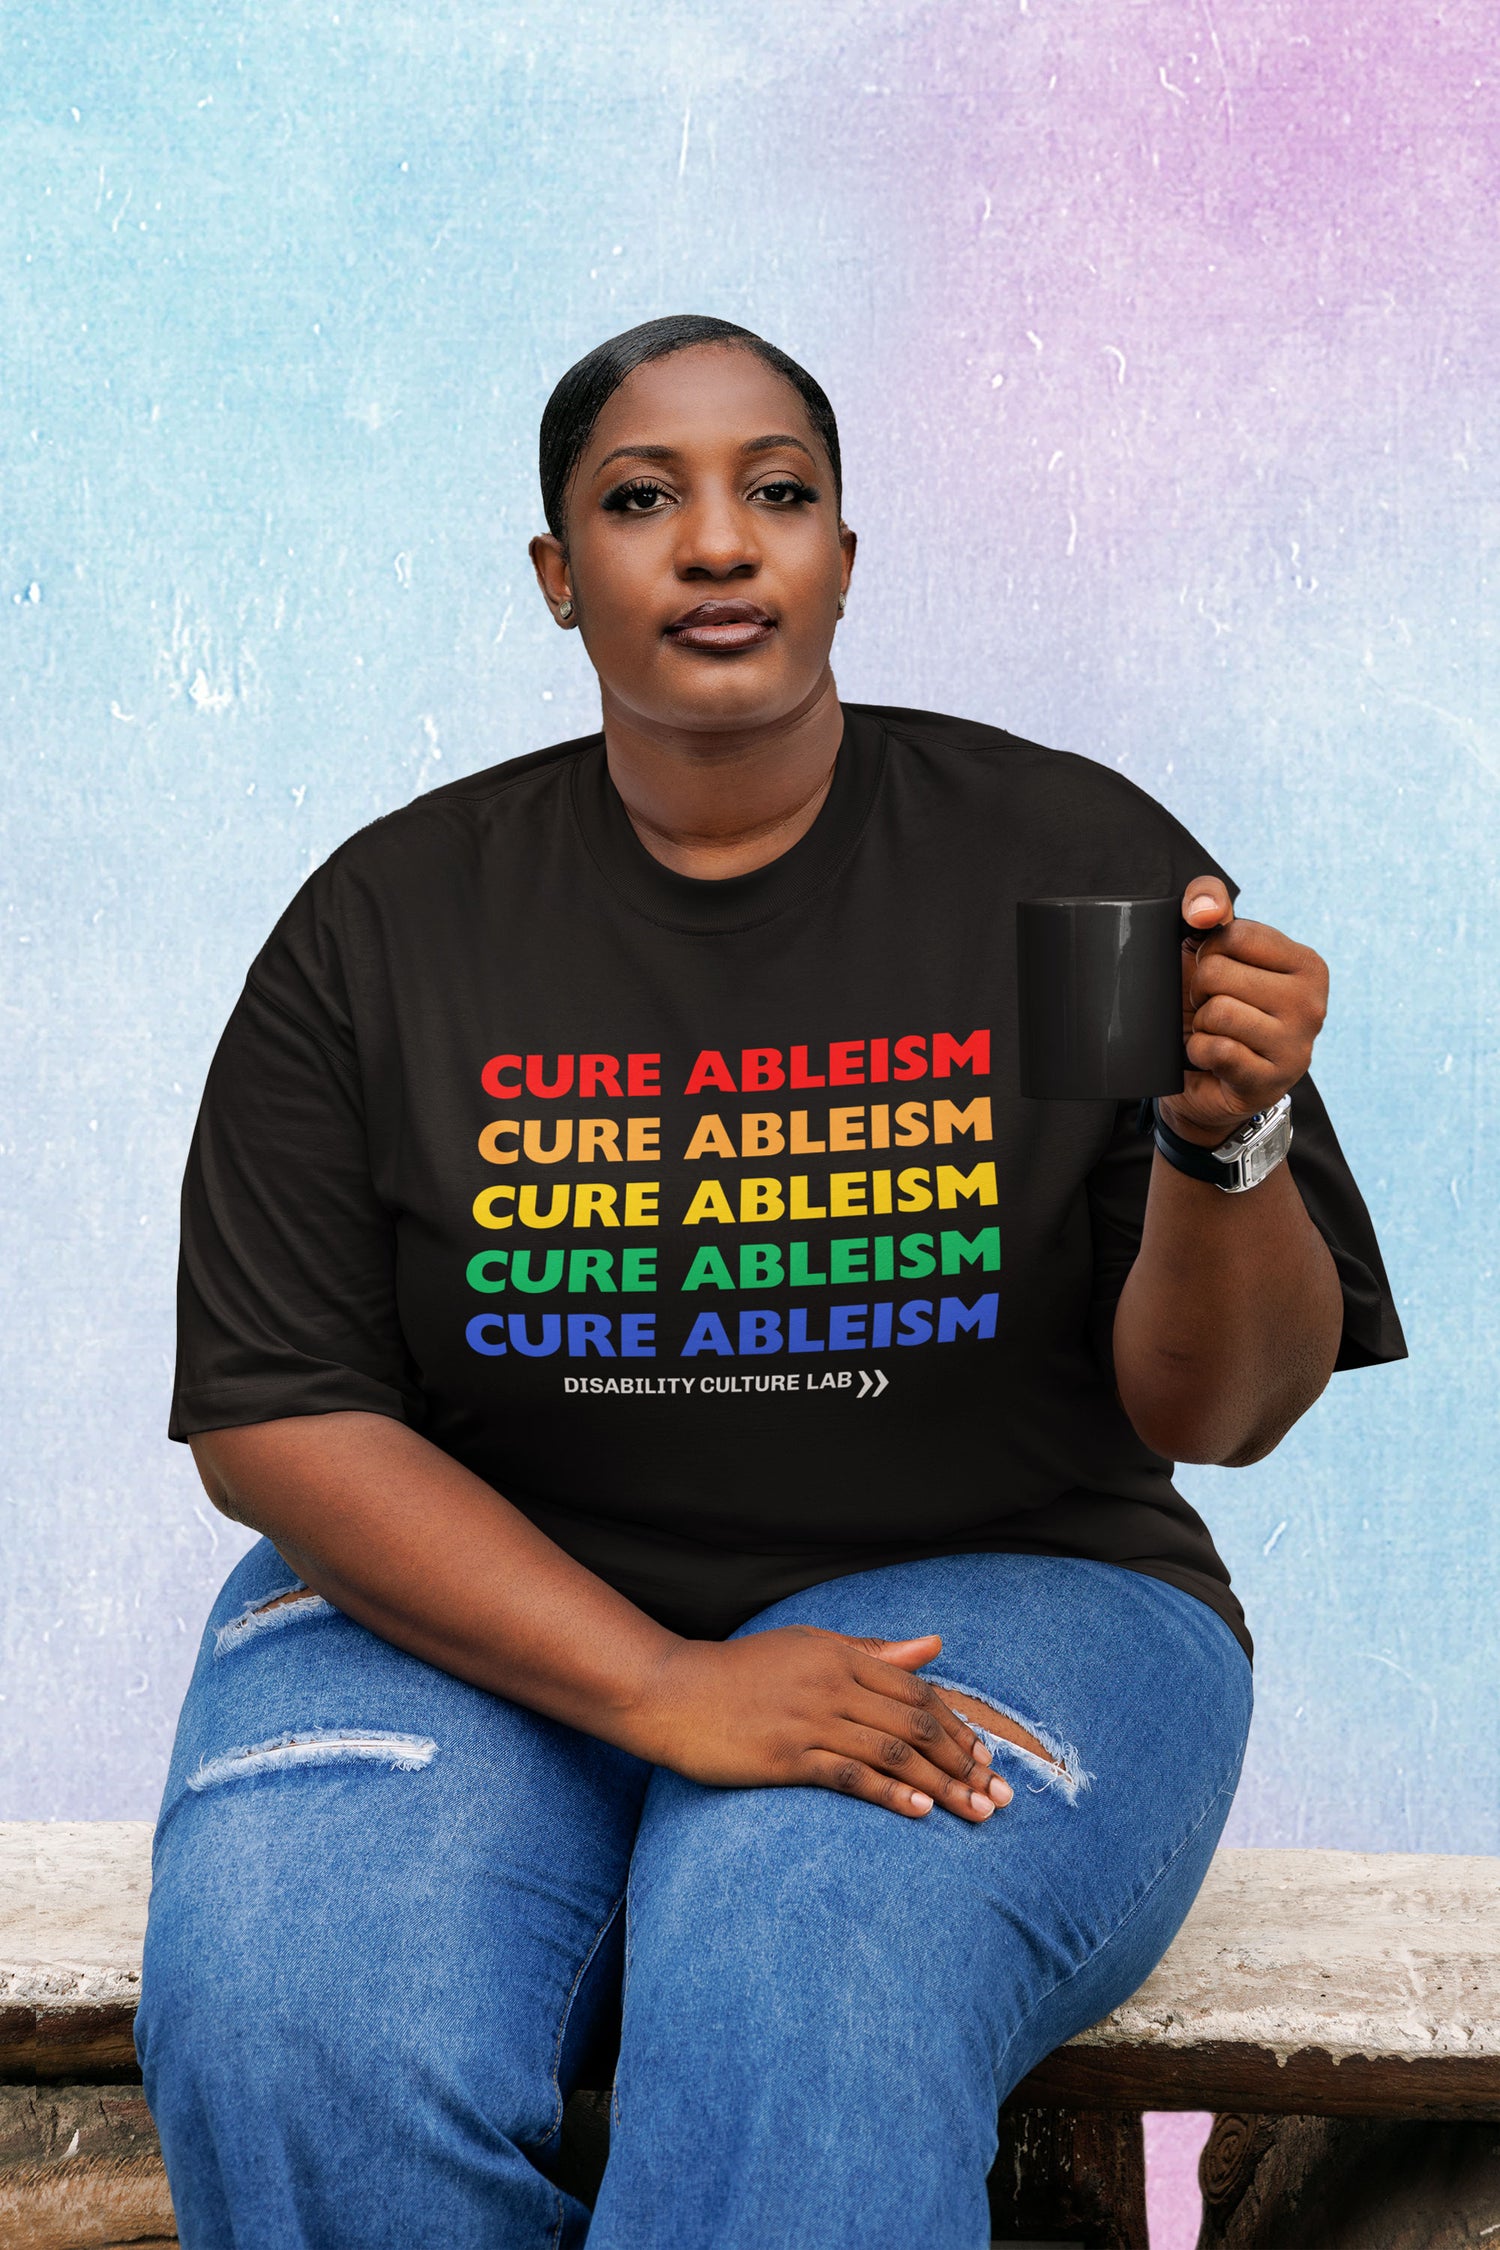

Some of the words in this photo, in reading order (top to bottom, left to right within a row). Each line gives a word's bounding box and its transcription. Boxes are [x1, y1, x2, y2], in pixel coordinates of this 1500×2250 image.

[480, 1053, 662, 1099] CURE
[683, 1029, 991, 1096] ABLEISM
[477, 1117, 661, 1165] CURE
[683, 1097, 994, 1160] ABLEISM
[472, 1182, 660, 1230] CURE
[681, 1162, 999, 1225] ABLEISM
[465, 1248, 658, 1294] CURE
[681, 1227, 1001, 1291] ABLEISM
[465, 1313, 657, 1358] CURE
[680, 1293, 999, 1357] ABLEISM
[564, 1377, 696, 1394] DISABILITY
[700, 1374, 800, 1393] CULTURE
[806, 1371, 852, 1390] LAB
